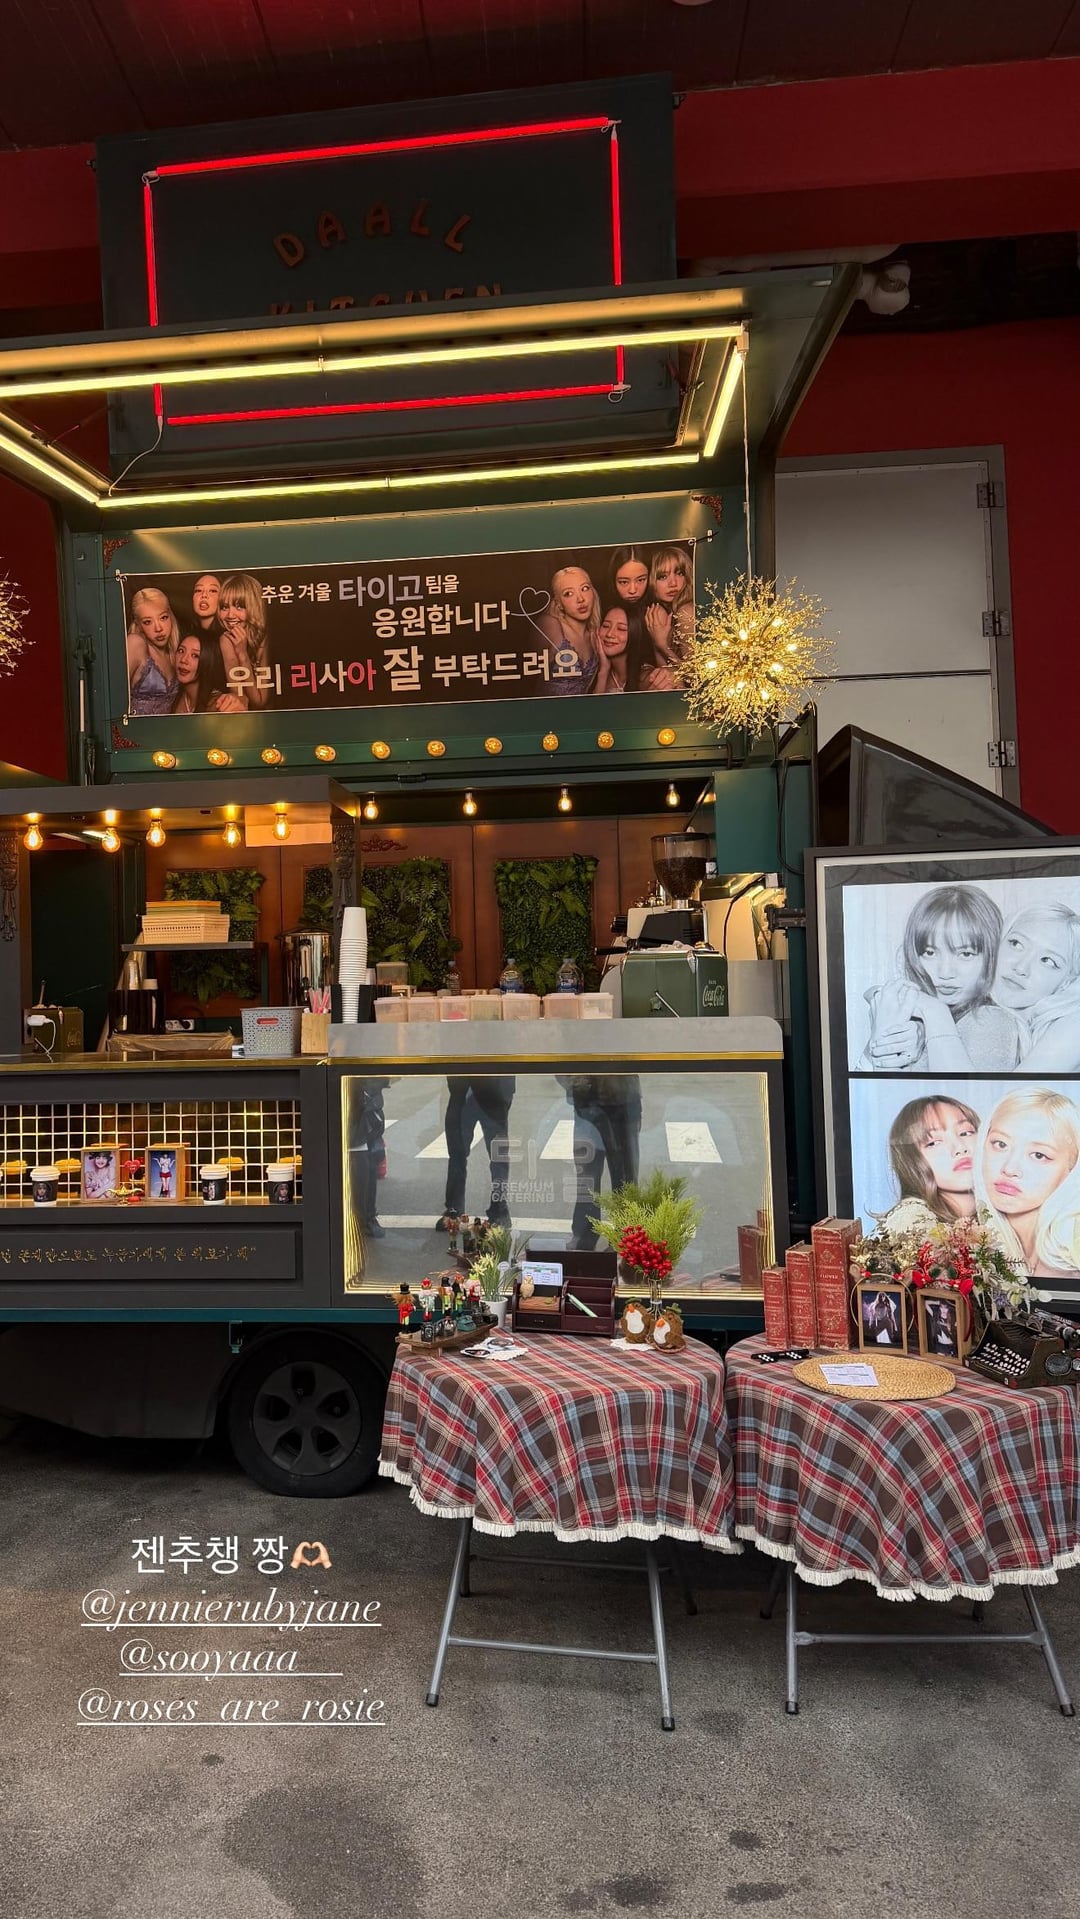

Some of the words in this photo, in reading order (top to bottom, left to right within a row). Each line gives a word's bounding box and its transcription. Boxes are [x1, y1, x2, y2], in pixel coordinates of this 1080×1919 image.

[261, 585, 294, 604] 추운
[298, 582, 331, 602] 겨울
[372, 601, 510, 638] 응원합니다
[226, 664, 282, 696] 우리
[290, 659, 377, 694] 리사아
[383, 645, 424, 692] 잘
[431, 649, 582, 687] 부탁드려요
[491, 1181, 554, 1192] PREMIUM
[492, 1191, 554, 1202] CATERING
